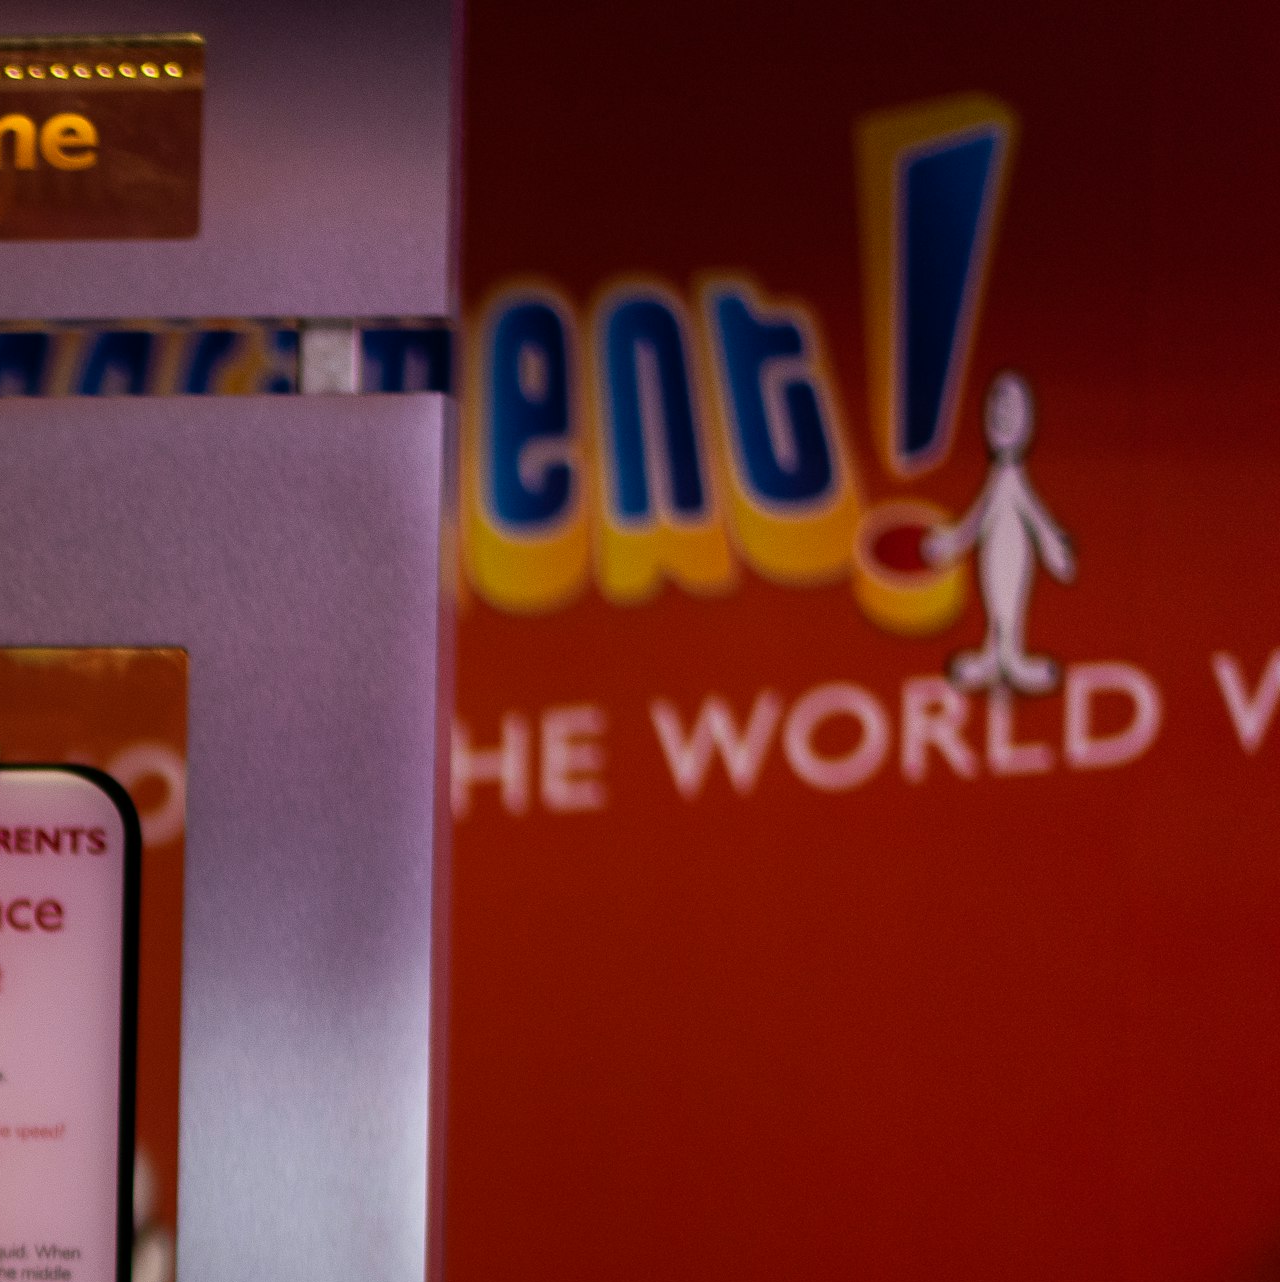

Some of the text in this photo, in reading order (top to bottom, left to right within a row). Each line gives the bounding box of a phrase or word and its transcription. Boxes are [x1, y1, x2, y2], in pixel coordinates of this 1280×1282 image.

[450, 704, 608, 818] HE
[630, 662, 1162, 796] WORLD
[34, 1243, 82, 1261] When
[21, 1266, 73, 1282] middle
